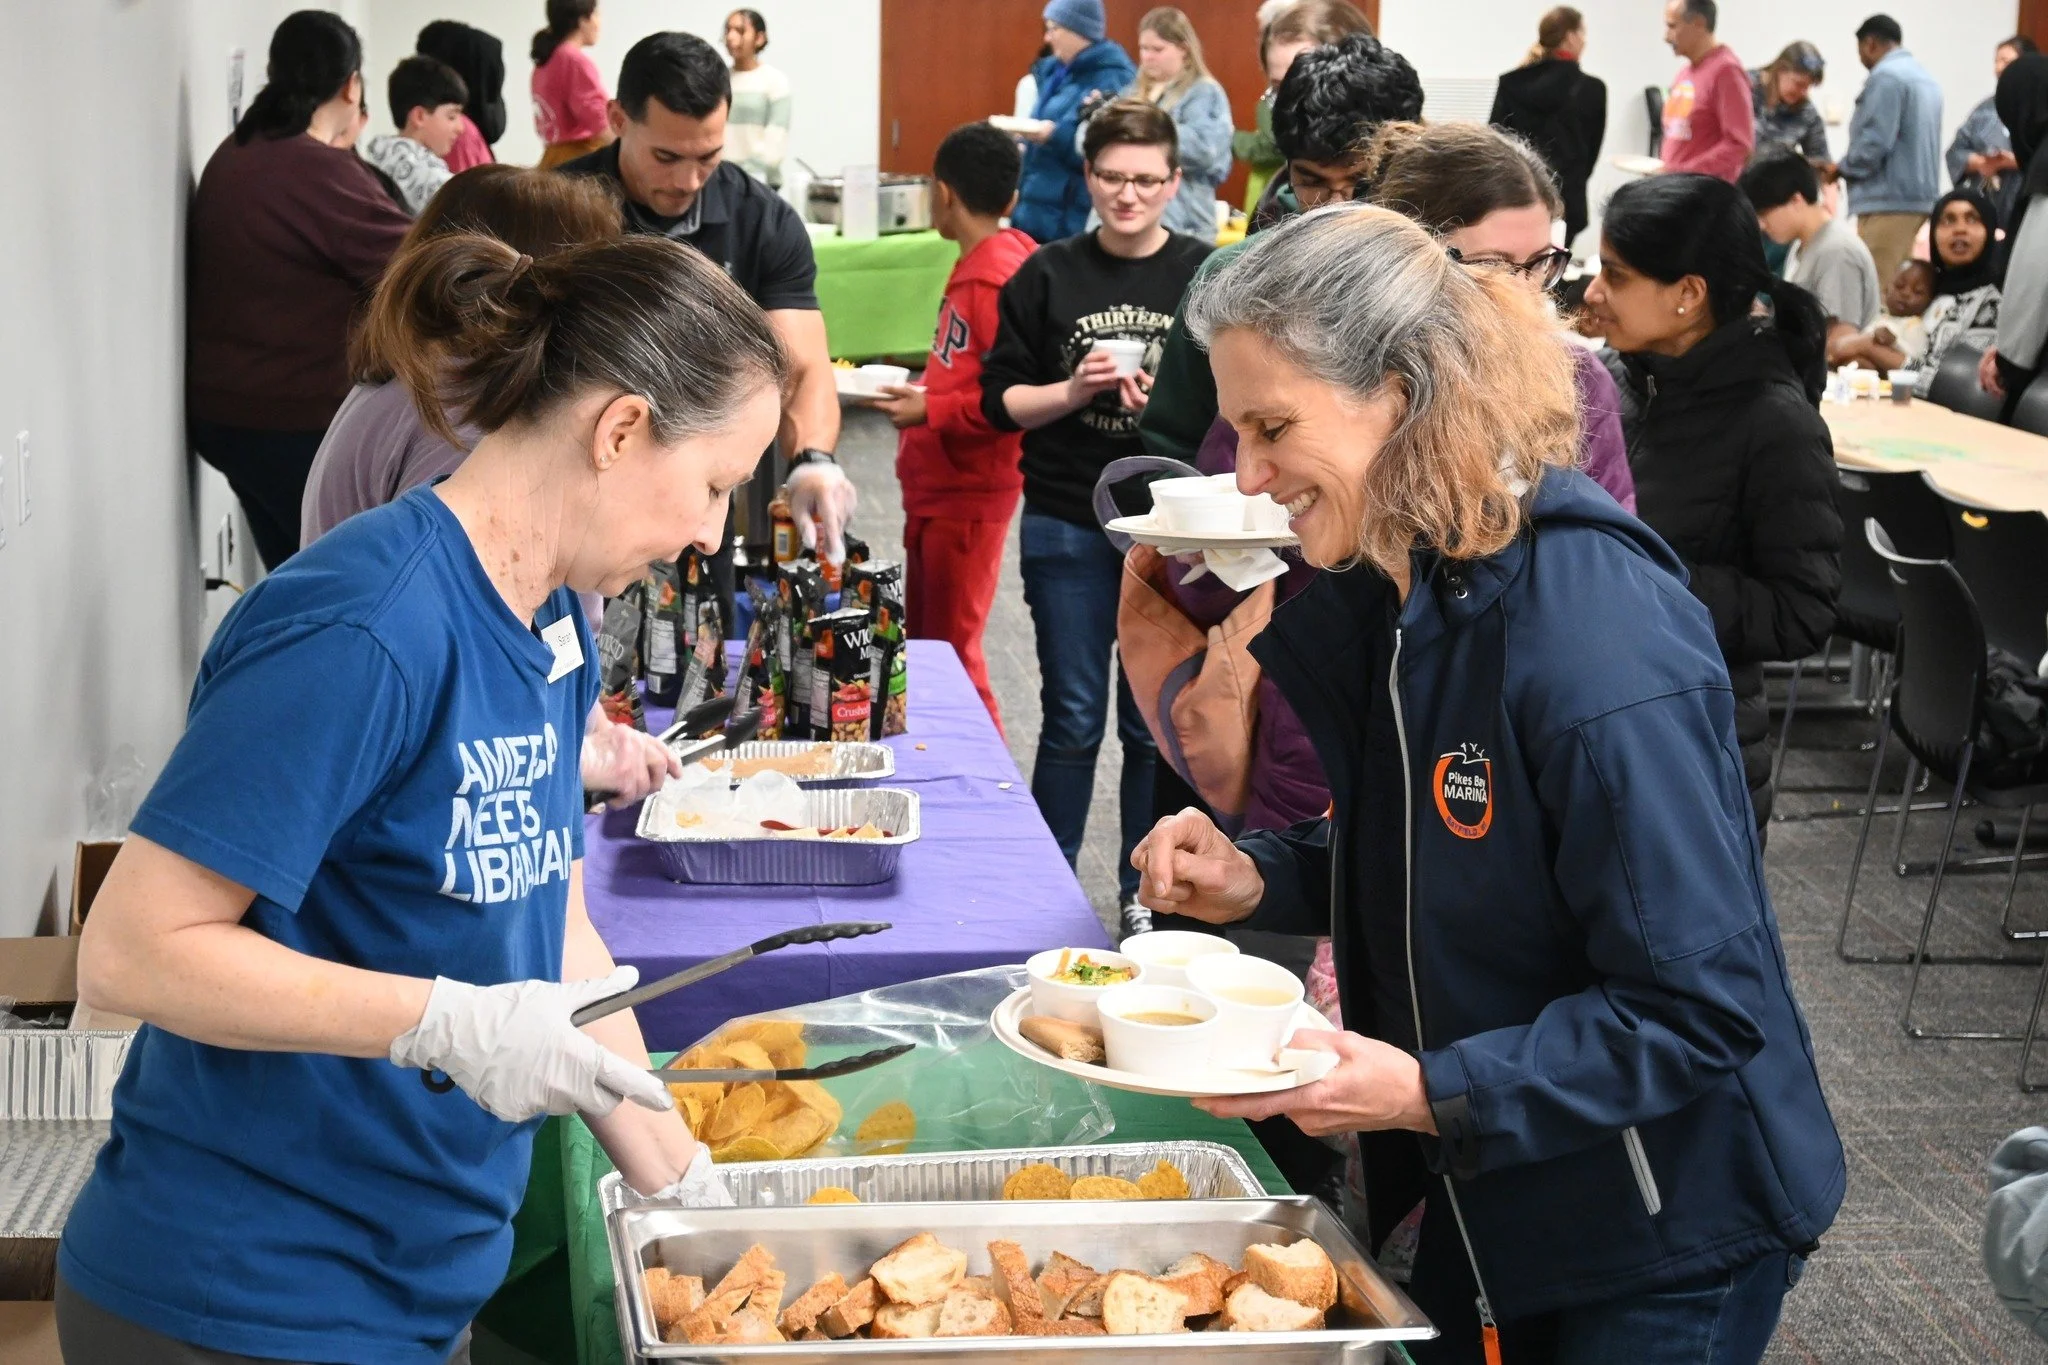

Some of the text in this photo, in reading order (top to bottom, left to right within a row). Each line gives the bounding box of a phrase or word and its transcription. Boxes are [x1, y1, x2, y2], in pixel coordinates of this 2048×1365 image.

[1076, 310, 1175, 333] THIRTEEN
[1448, 771, 1486, 791] Pikes Bay
[1444, 784, 1488, 804] MARINA
